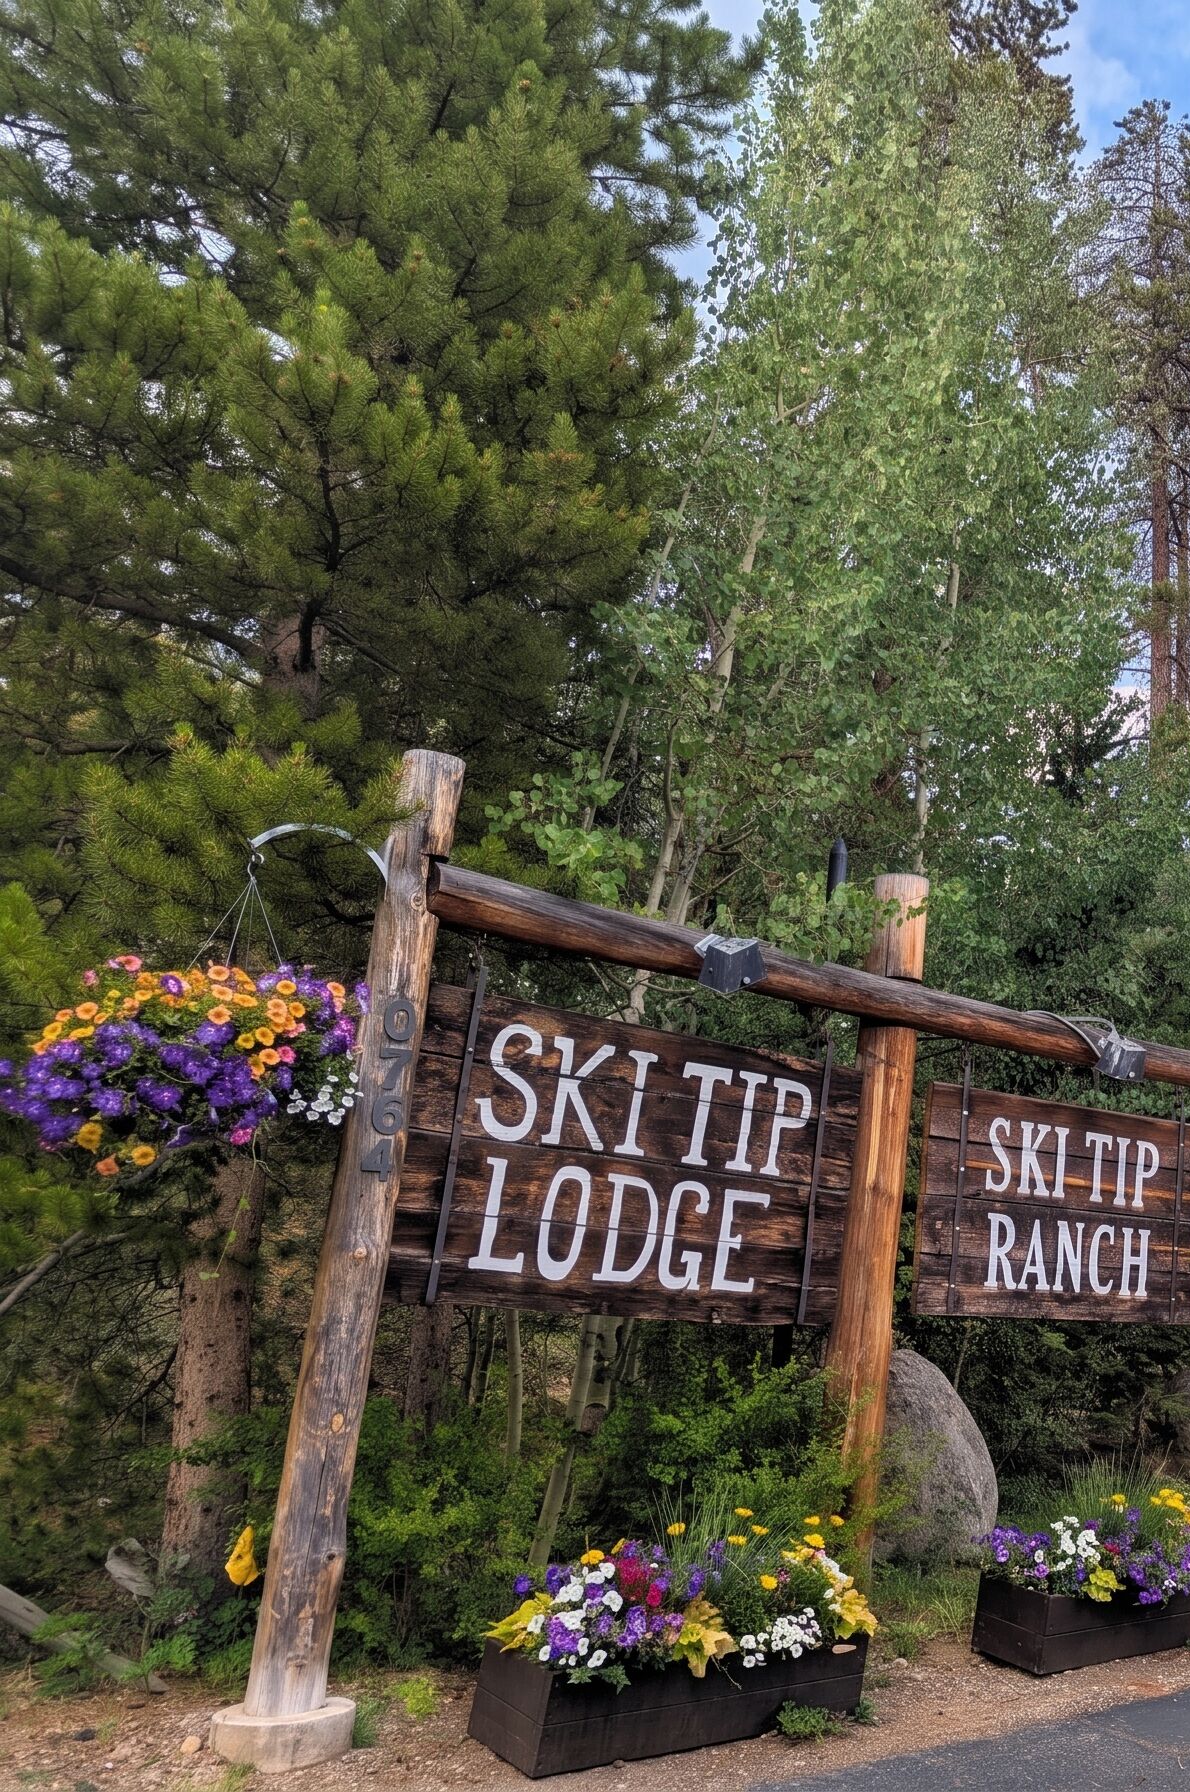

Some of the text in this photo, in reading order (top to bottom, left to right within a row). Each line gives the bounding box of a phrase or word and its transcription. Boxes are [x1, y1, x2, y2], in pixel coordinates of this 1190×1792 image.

[361, 999, 416, 1182] 0764
[474, 1023, 812, 1177] SKI TIP
[468, 1157, 771, 1293] LODGE
[985, 1117, 1160, 1210] SKI TIP
[983, 1212, 1151, 1297] RANCH
